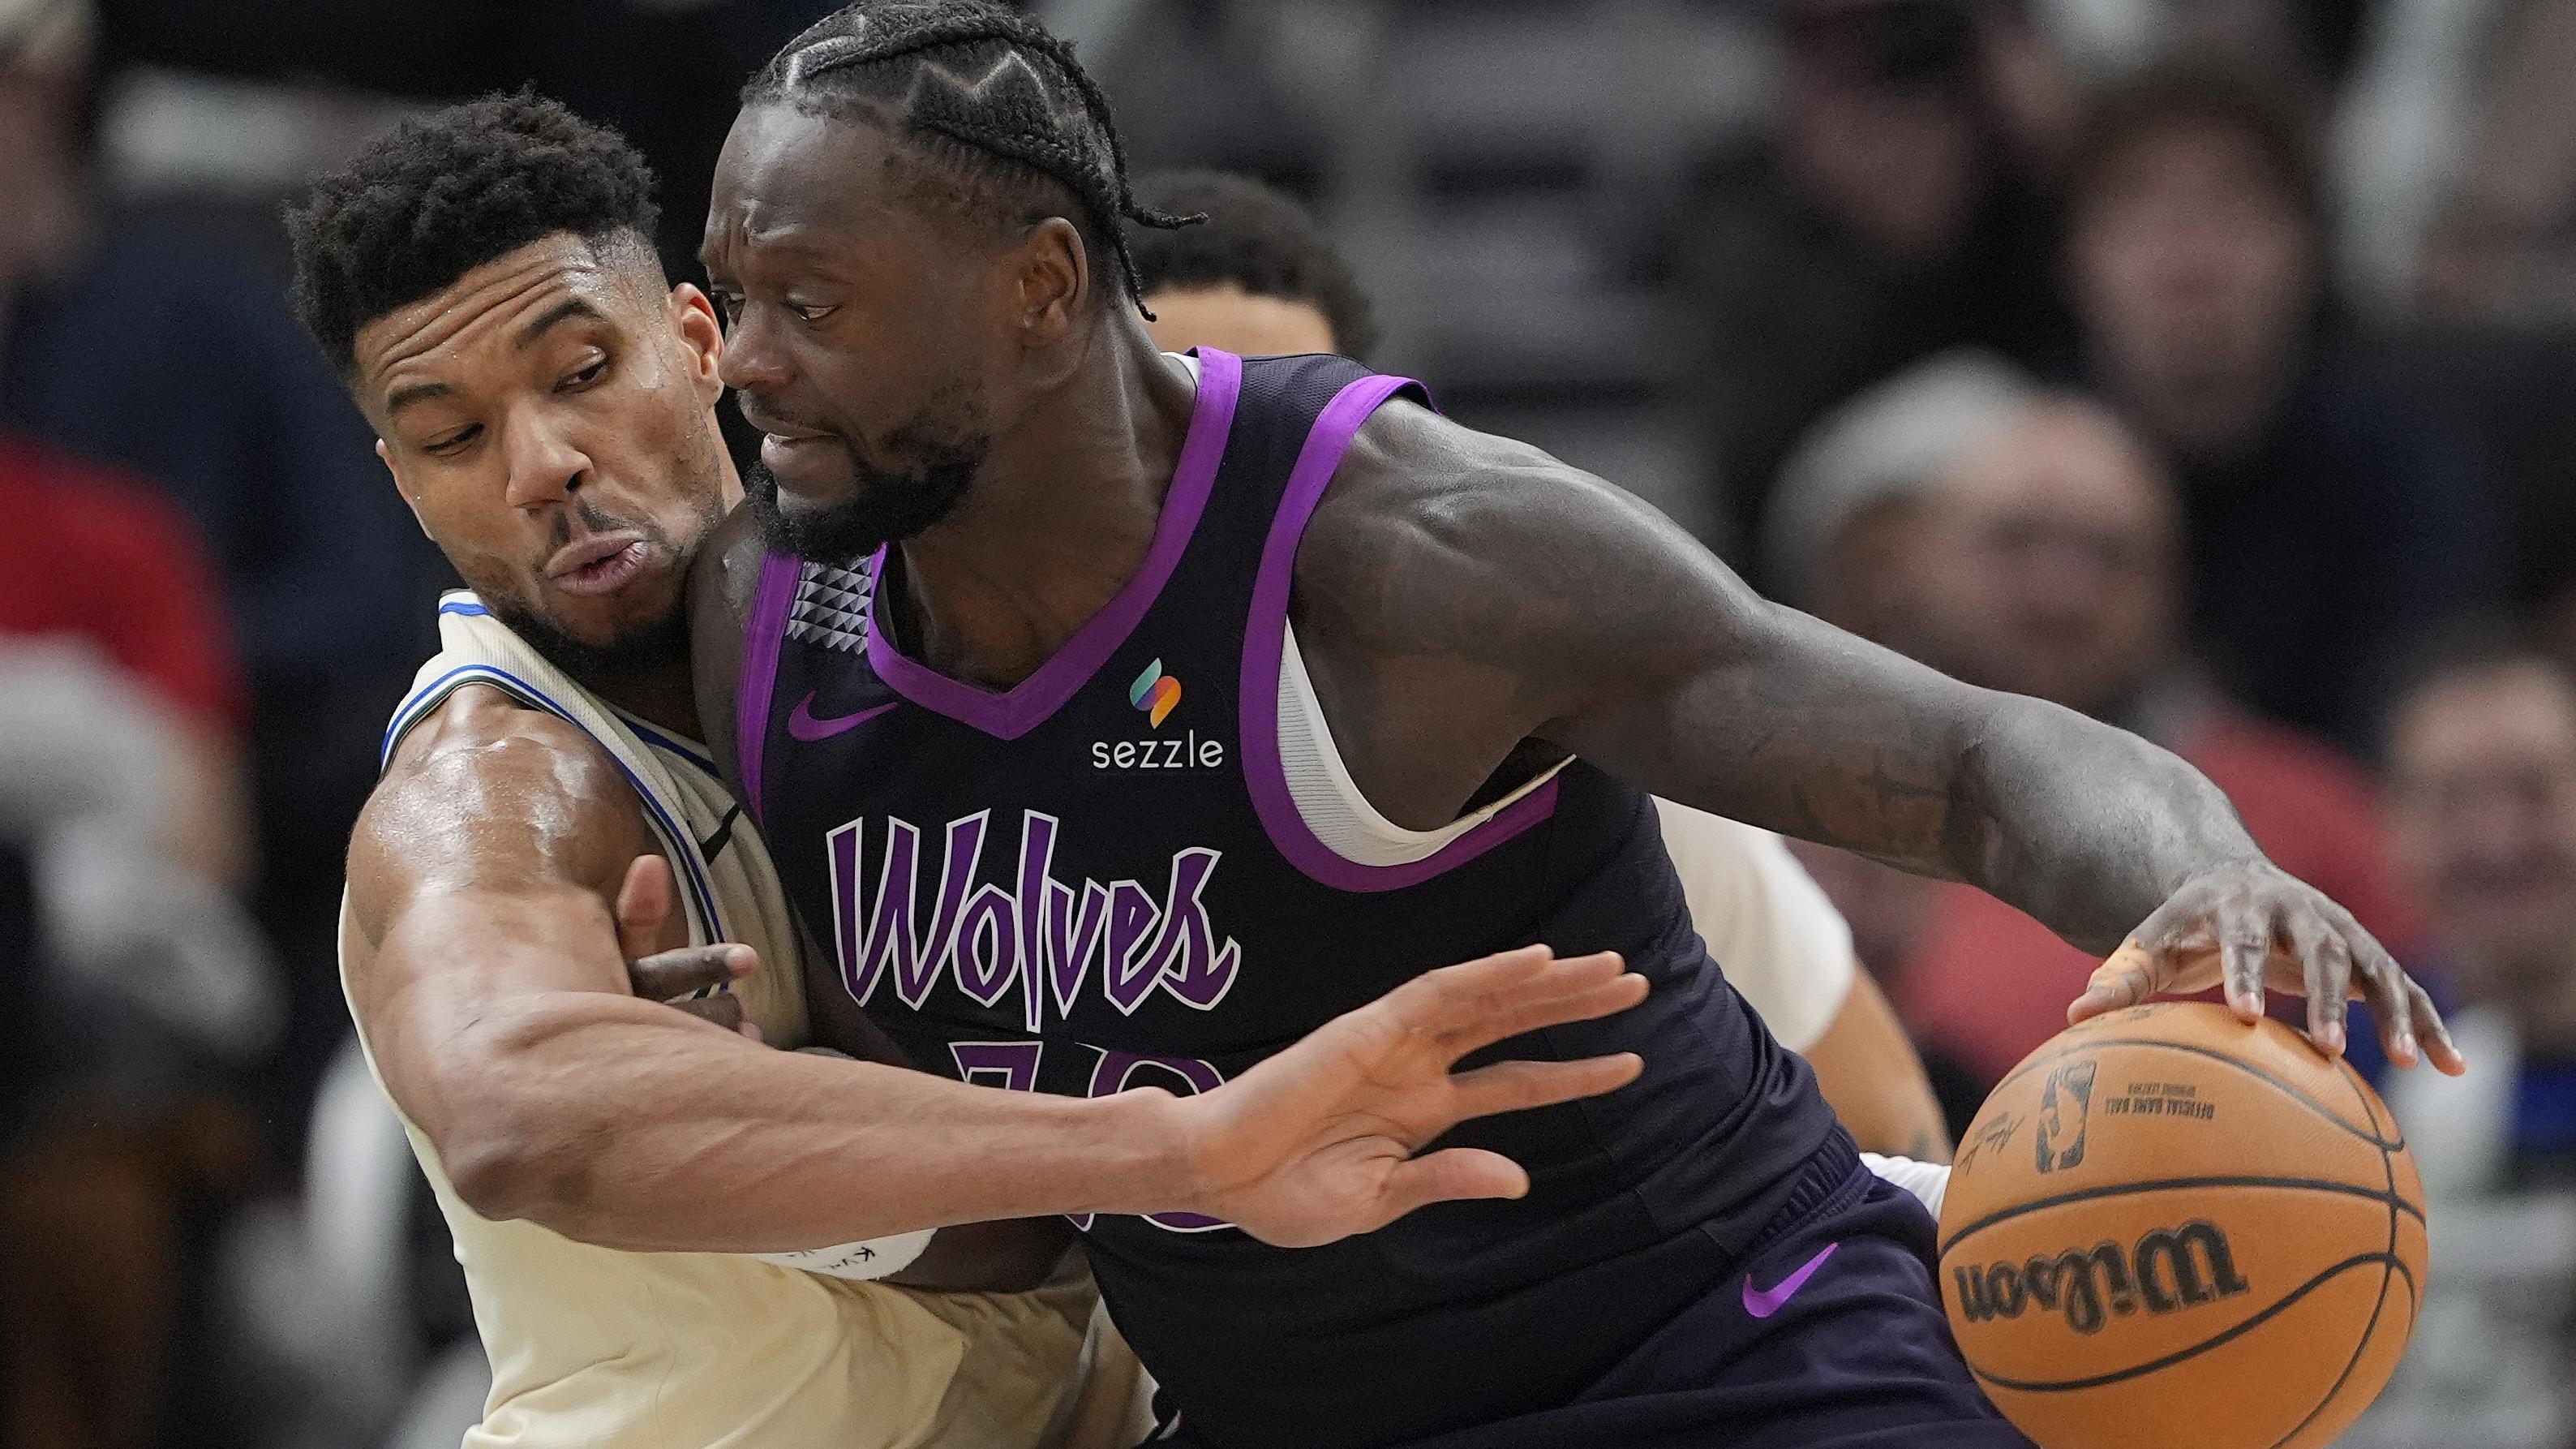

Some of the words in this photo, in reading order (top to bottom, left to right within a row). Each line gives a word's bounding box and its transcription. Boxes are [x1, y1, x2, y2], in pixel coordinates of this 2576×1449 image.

[1092, 729, 1224, 769] sezzle
[826, 808, 1242, 1034] Wolves
[1954, 1219, 2250, 1335] Wilson
